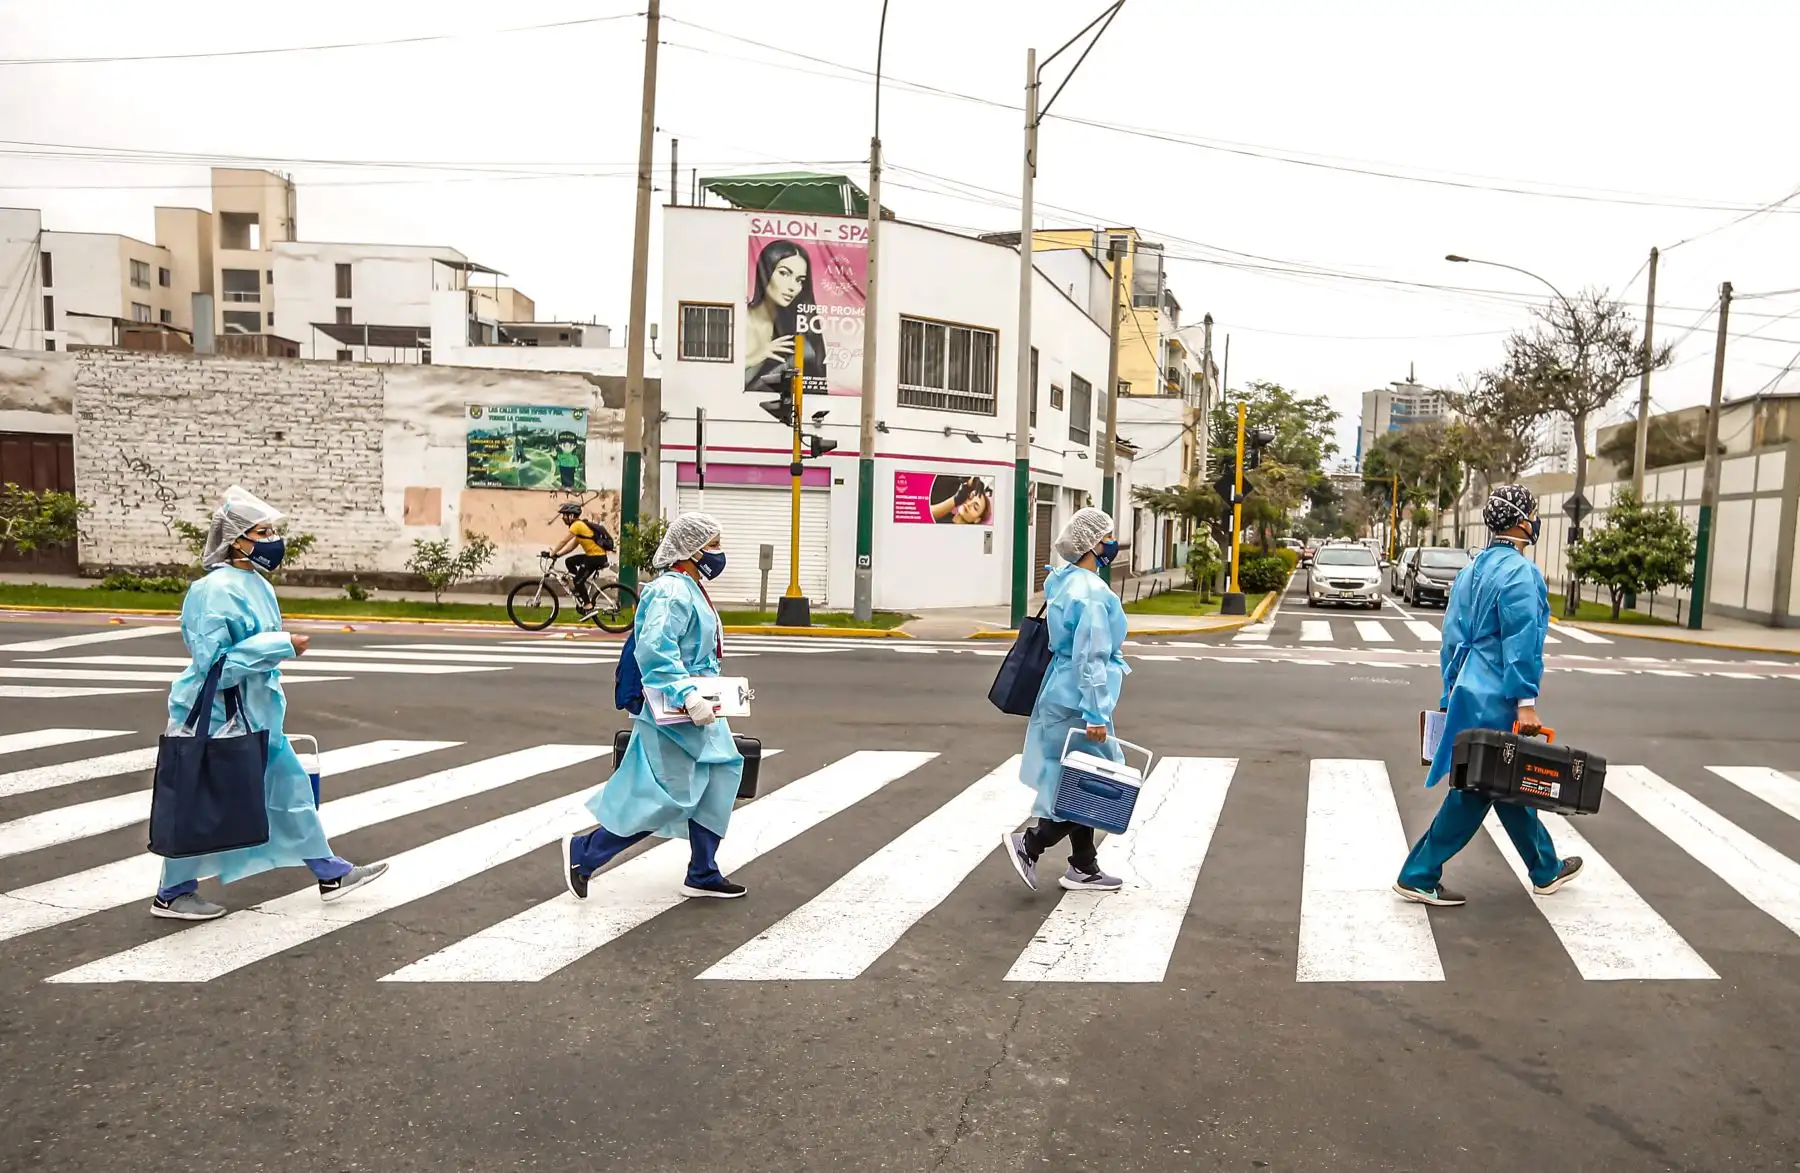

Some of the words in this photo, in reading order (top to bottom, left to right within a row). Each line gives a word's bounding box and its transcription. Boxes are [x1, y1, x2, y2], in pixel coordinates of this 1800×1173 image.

[751, 218, 817, 237] SALON
[796, 303, 829, 315] SUPER
[1533, 765, 1559, 777] TRUPER
